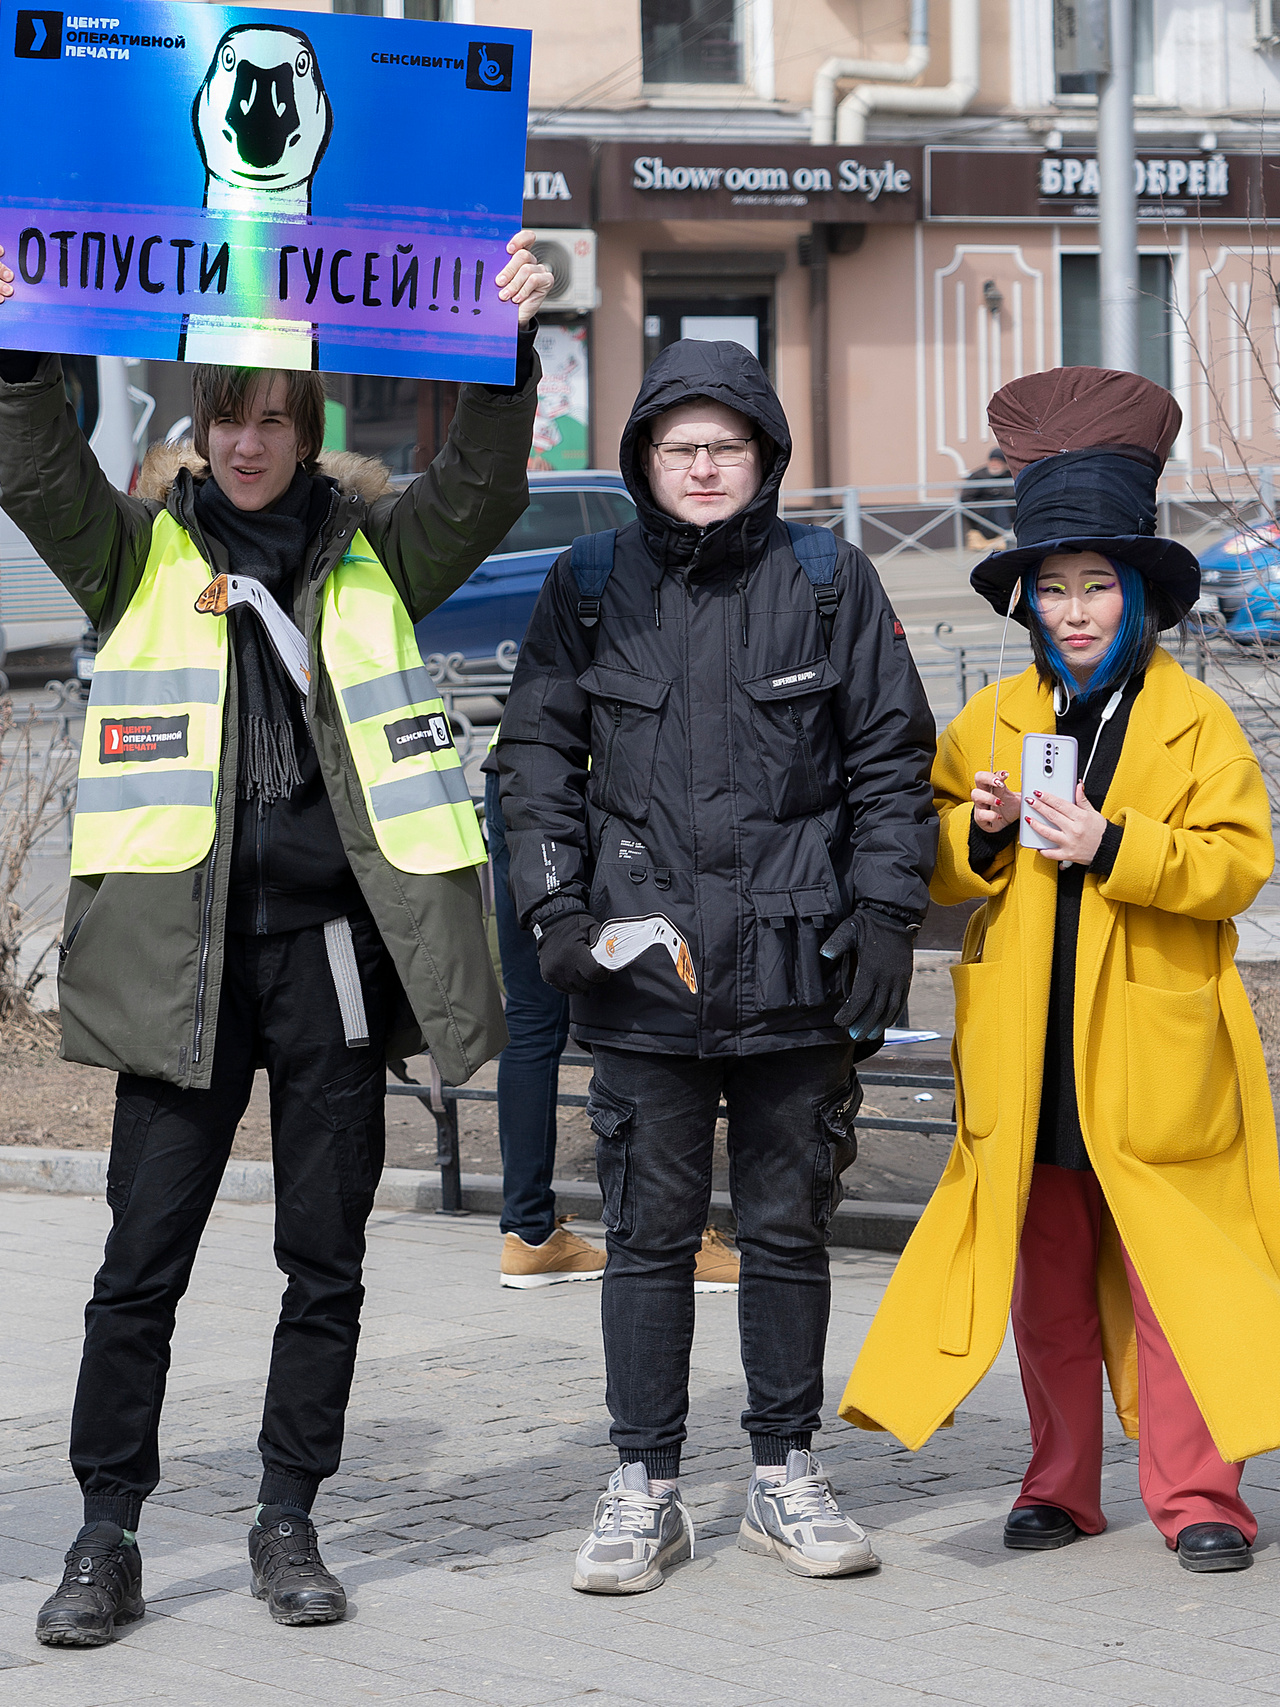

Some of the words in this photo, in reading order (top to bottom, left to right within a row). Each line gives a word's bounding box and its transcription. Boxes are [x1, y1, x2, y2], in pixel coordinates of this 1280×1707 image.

[66, 16, 120, 30] ЦЕНТР
[66, 31, 186, 49] ОПЕРАТИВНОЙ
[65, 45, 130, 60] ПЕЧАТИ
[370, 52, 465, 70] СЕНСИВИТИ
[793, 167, 834, 192] on
[838, 159, 911, 202] Style
[1040, 153, 1229, 196] БРАОБРЕЙ
[18, 226, 230, 295] ОТПУСТИ
[279, 243, 485, 316] ГУСЕЙ!!!
[123, 725, 152, 735] ЦЕНТР
[123, 730, 182, 743] ОПЕРАТИВНОЙ
[123, 743, 157, 752] ПЕЧАТИ
